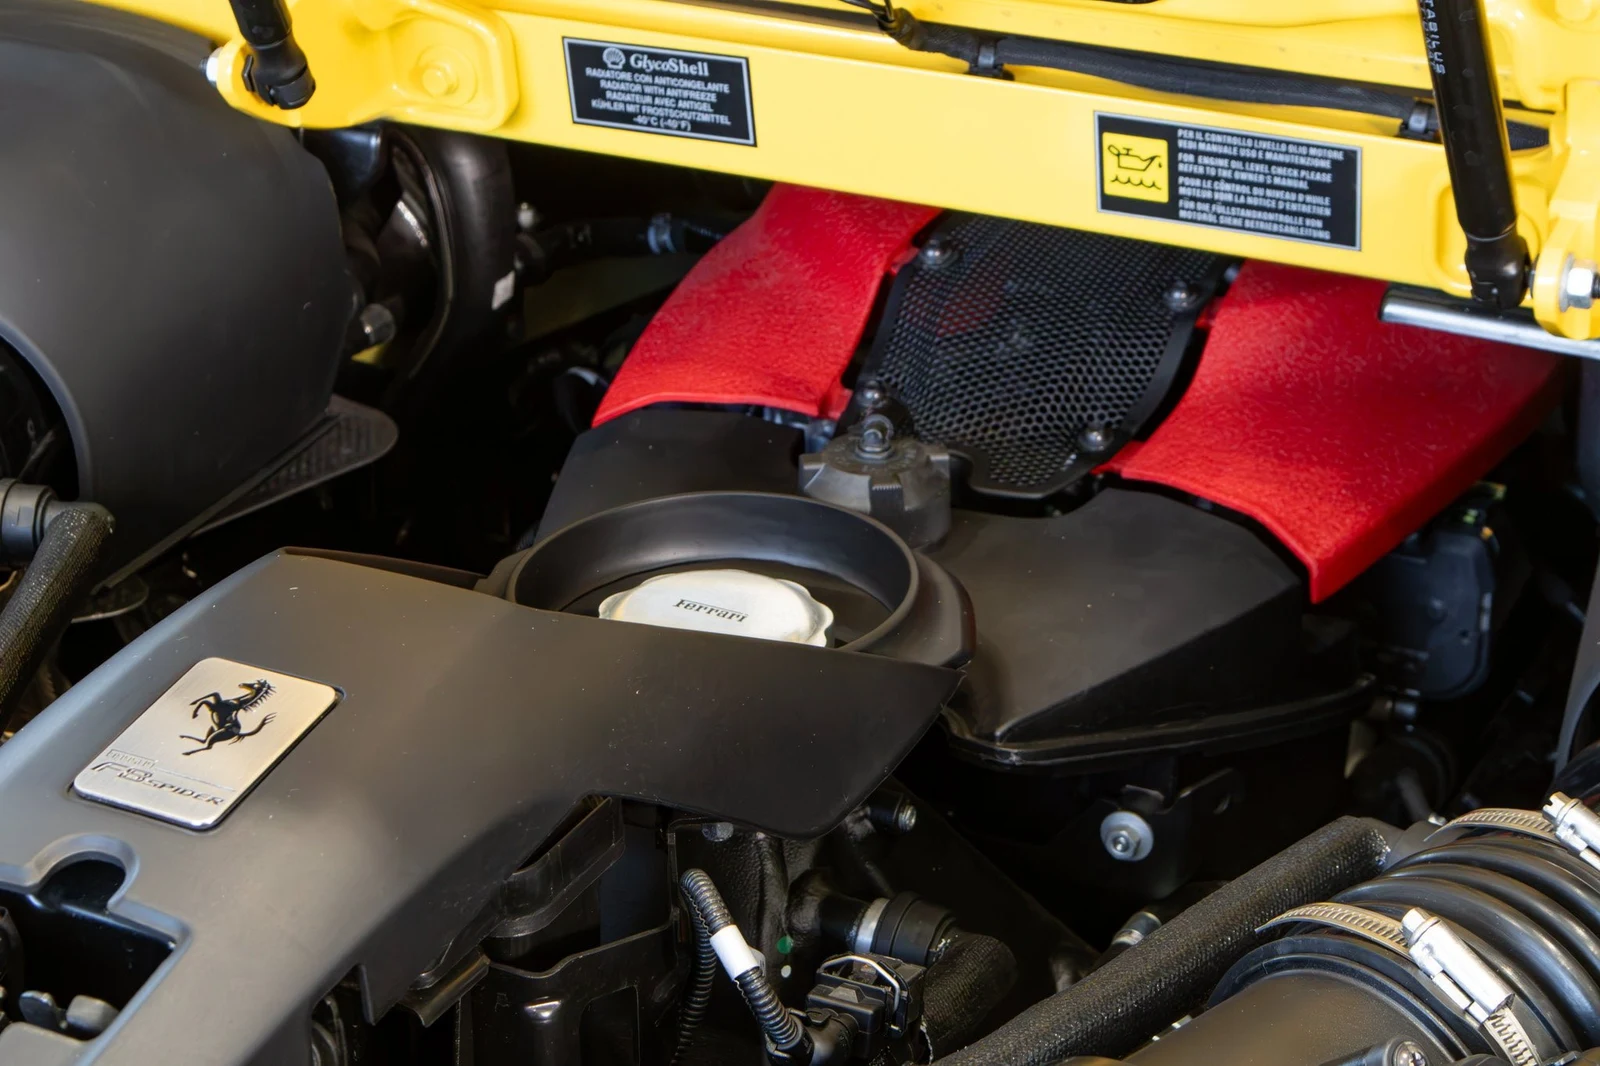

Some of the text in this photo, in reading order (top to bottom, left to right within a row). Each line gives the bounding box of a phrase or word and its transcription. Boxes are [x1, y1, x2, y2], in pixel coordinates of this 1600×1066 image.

[630, 53, 710, 76] GlycoShell
[585, 67, 730, 93] RADIATORE CON ANTICONGELANTE
[600, 80, 717, 102] RADIATOR WITH ANTIFREEZE
[591, 98, 731, 125] KÜHLER MIT FROSTSCHUTZMITTEL
[606, 90, 713, 112] RADIATEUR AVEC ANTIGEL
[1177, 128, 1344, 161] PER IL CONTROLLO LIVELLO OLIO MOTORE
[1177, 139, 1332, 169] VEDI MANUALE USO E MANUTENZIONE
[1178, 152, 1332, 183] FOR ENGINE OIL LEVEL CHECK PLEASE
[1178, 163, 1309, 190] REFER TO THE OWNER'S MANUAL
[1178, 176, 1201, 188] POUR
[1202, 179, 1212, 189] LE
[1252, 186, 1265, 196] DU
[1265, 188, 1297, 201] NIVEAU
[1178, 186, 1212, 199] MOTEUR
[1213, 191, 1234, 202] VOIR
[1235, 194, 1245, 204] LA
[1247, 196, 1277, 209] NOTICE
[1178, 197, 1196, 210] FÜR
[1196, 201, 1211, 211] DIE
[1305, 218, 1323, 228] VON
[1219, 215, 1243, 227] SIEHE
[673, 599, 748, 622] Ferrari
[105, 749, 157, 768] Ferrari
[91, 761, 224, 805] F8 SPIDER
